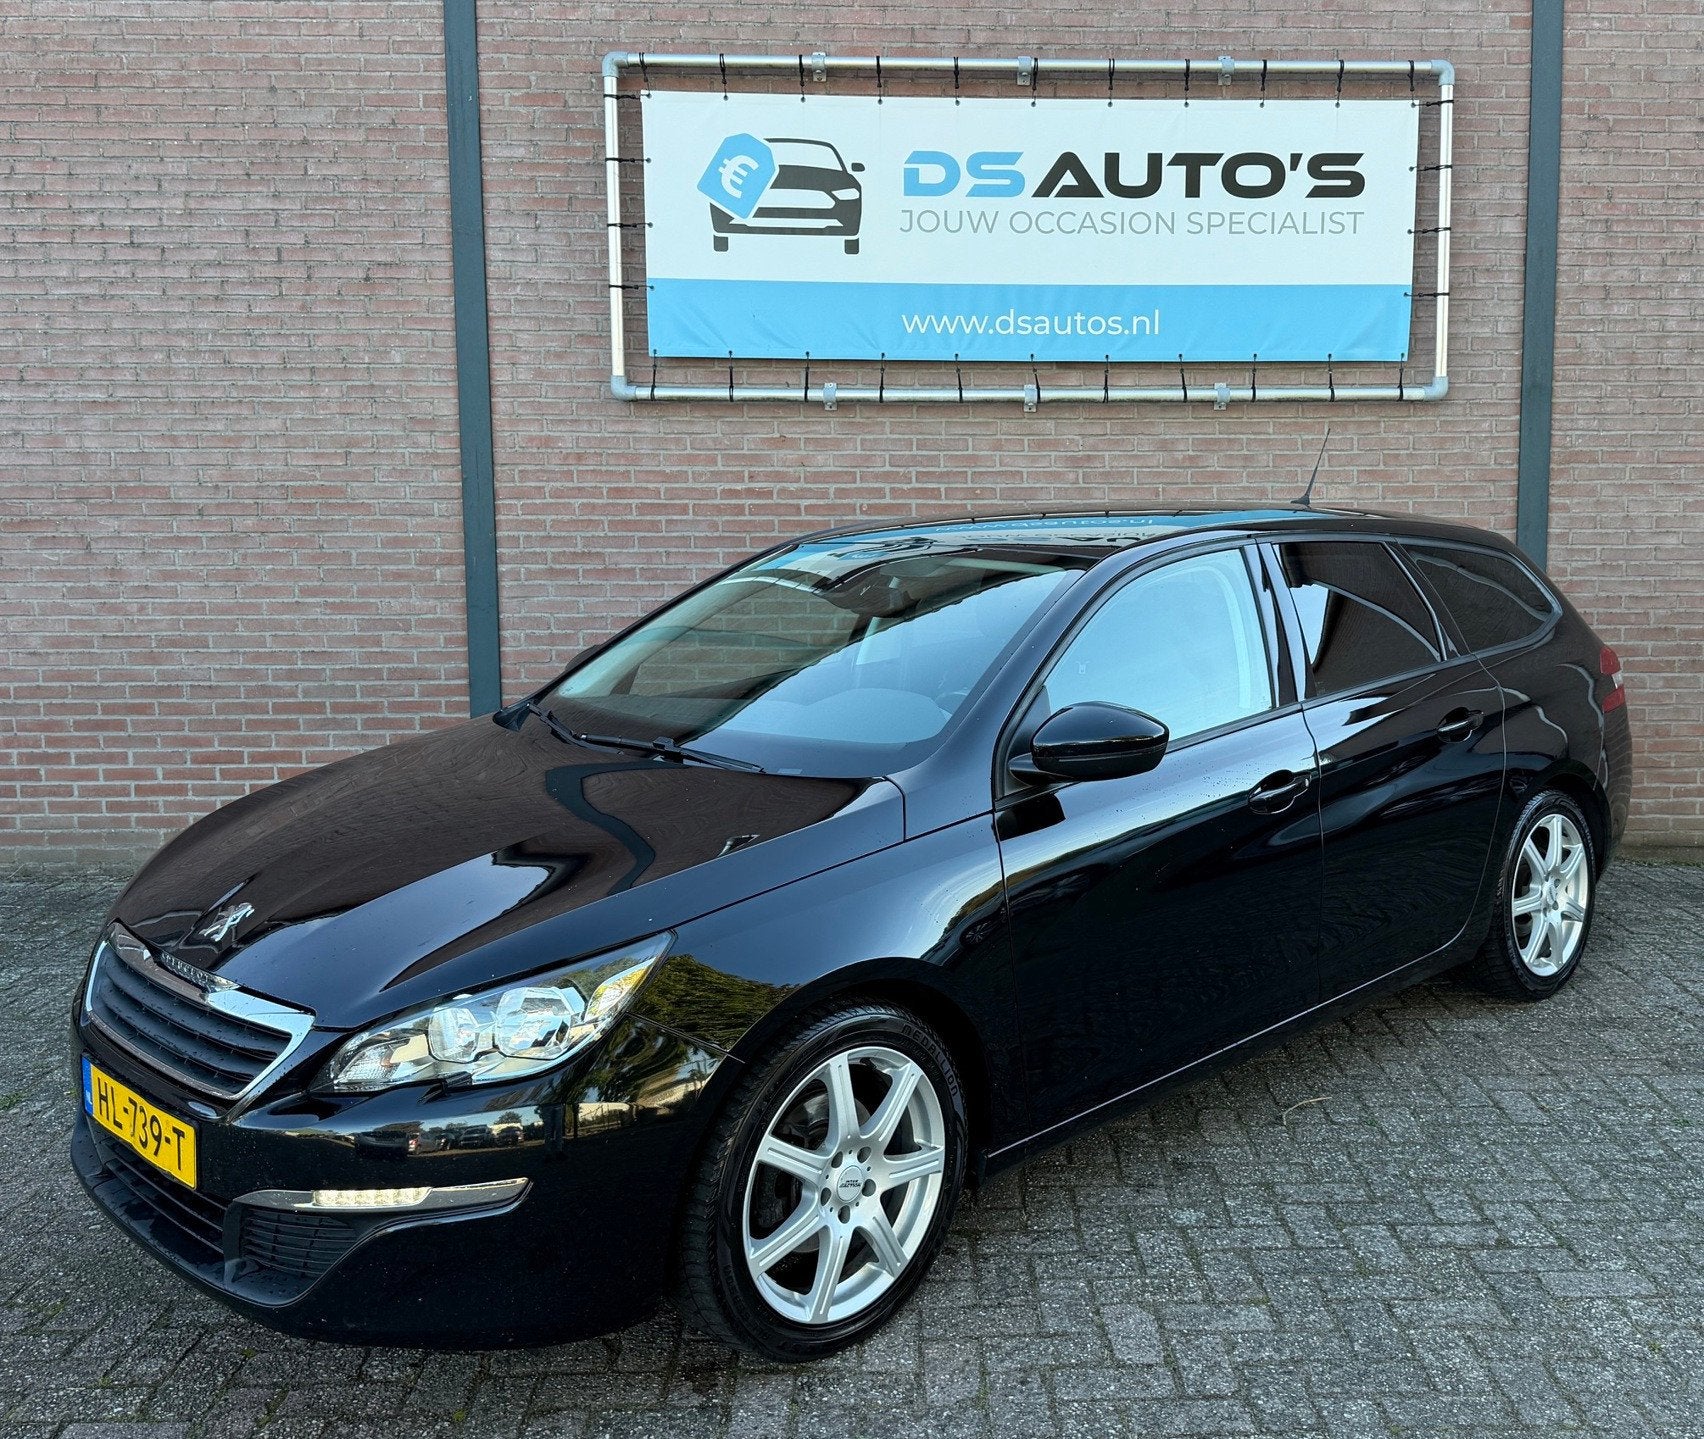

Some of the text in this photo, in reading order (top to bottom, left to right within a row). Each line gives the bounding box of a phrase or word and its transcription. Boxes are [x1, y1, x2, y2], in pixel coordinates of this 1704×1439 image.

[900, 209, 1364, 235] JOUW OCCASION SPECIALIST
[902, 308, 1160, 335] www.dsautos.nl
[97, 1076, 186, 1171] HL-739-T
